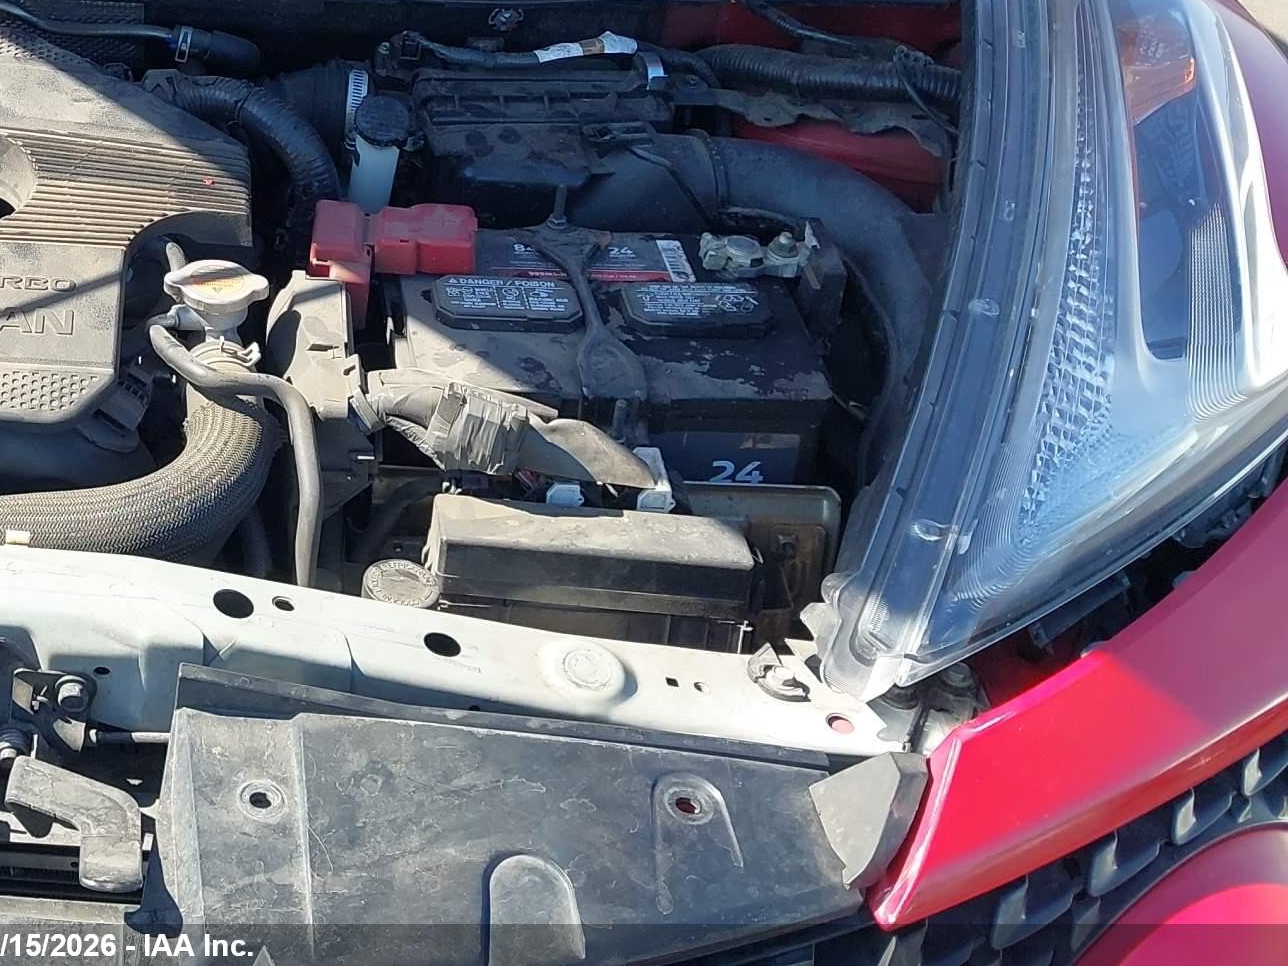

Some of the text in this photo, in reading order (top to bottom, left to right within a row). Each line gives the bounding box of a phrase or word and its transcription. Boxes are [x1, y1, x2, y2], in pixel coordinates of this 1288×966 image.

[459, 277, 503, 286] DANGER
[515, 280, 555, 288] POISON
[708, 460, 764, 484] 24
